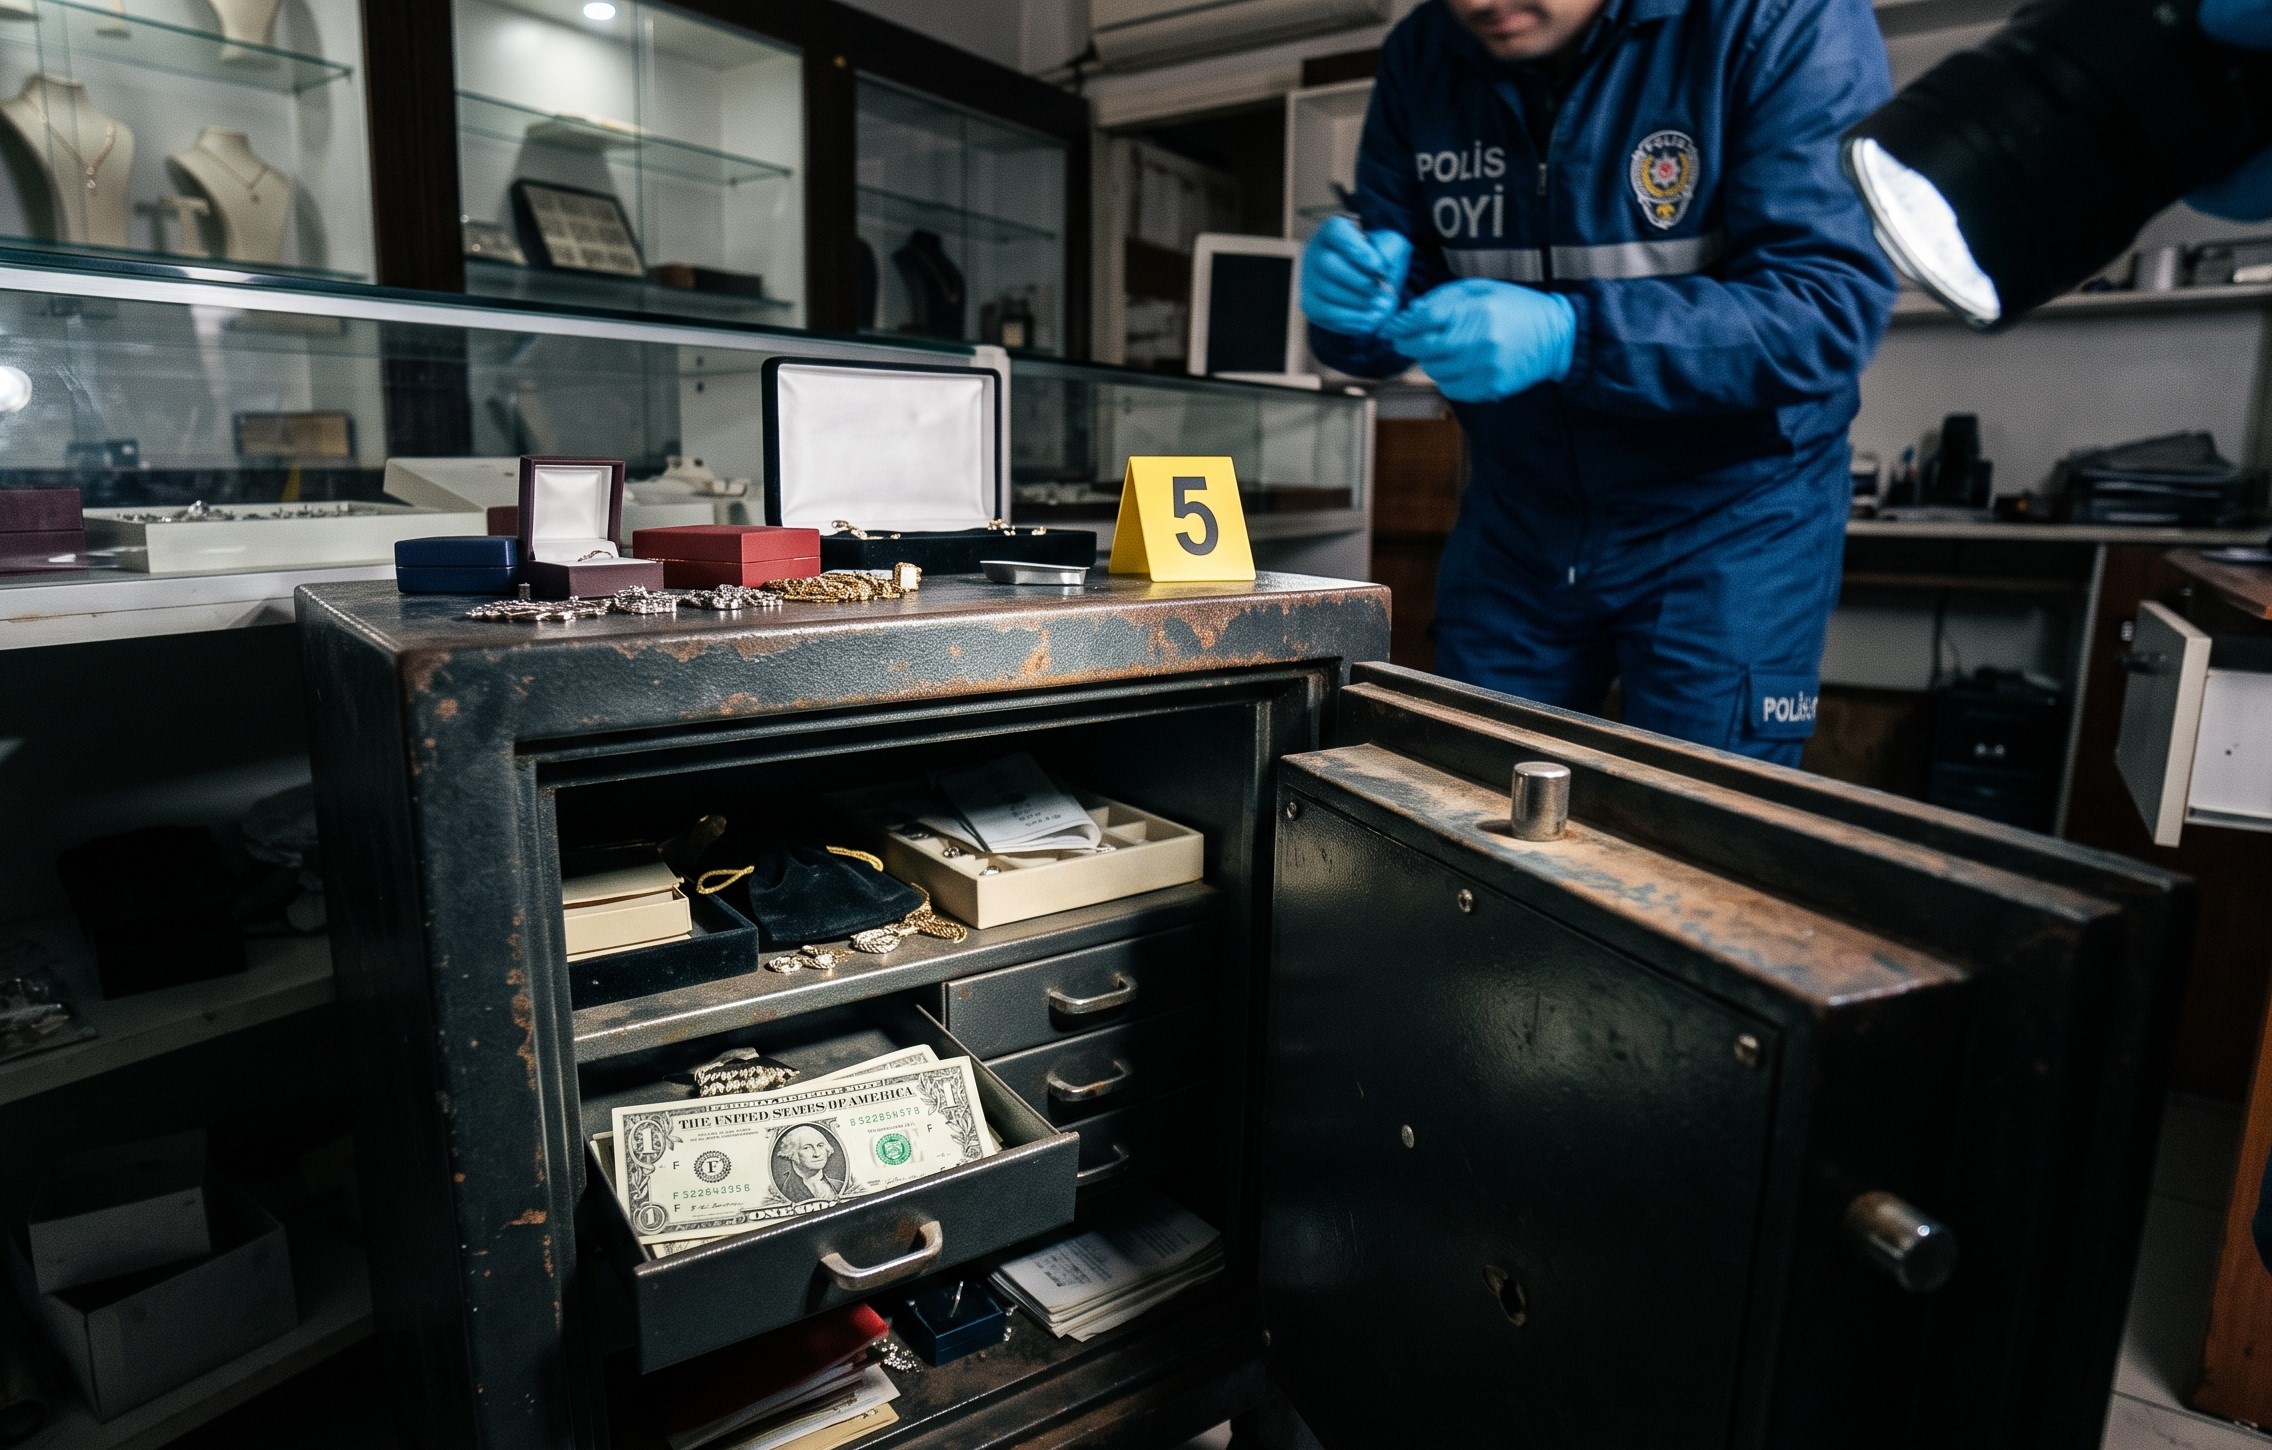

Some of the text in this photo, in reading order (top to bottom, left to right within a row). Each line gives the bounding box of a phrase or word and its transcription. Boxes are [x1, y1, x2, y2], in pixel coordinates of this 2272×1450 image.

[1415, 140, 1506, 183] POLİS
[1433, 184, 1504, 239] OYİ
[1172, 476, 1219, 556] 5
[678, 1116, 711, 1130] THE
[848, 1086, 915, 1107] AMERICA
[706, 1160, 719, 1173] F
